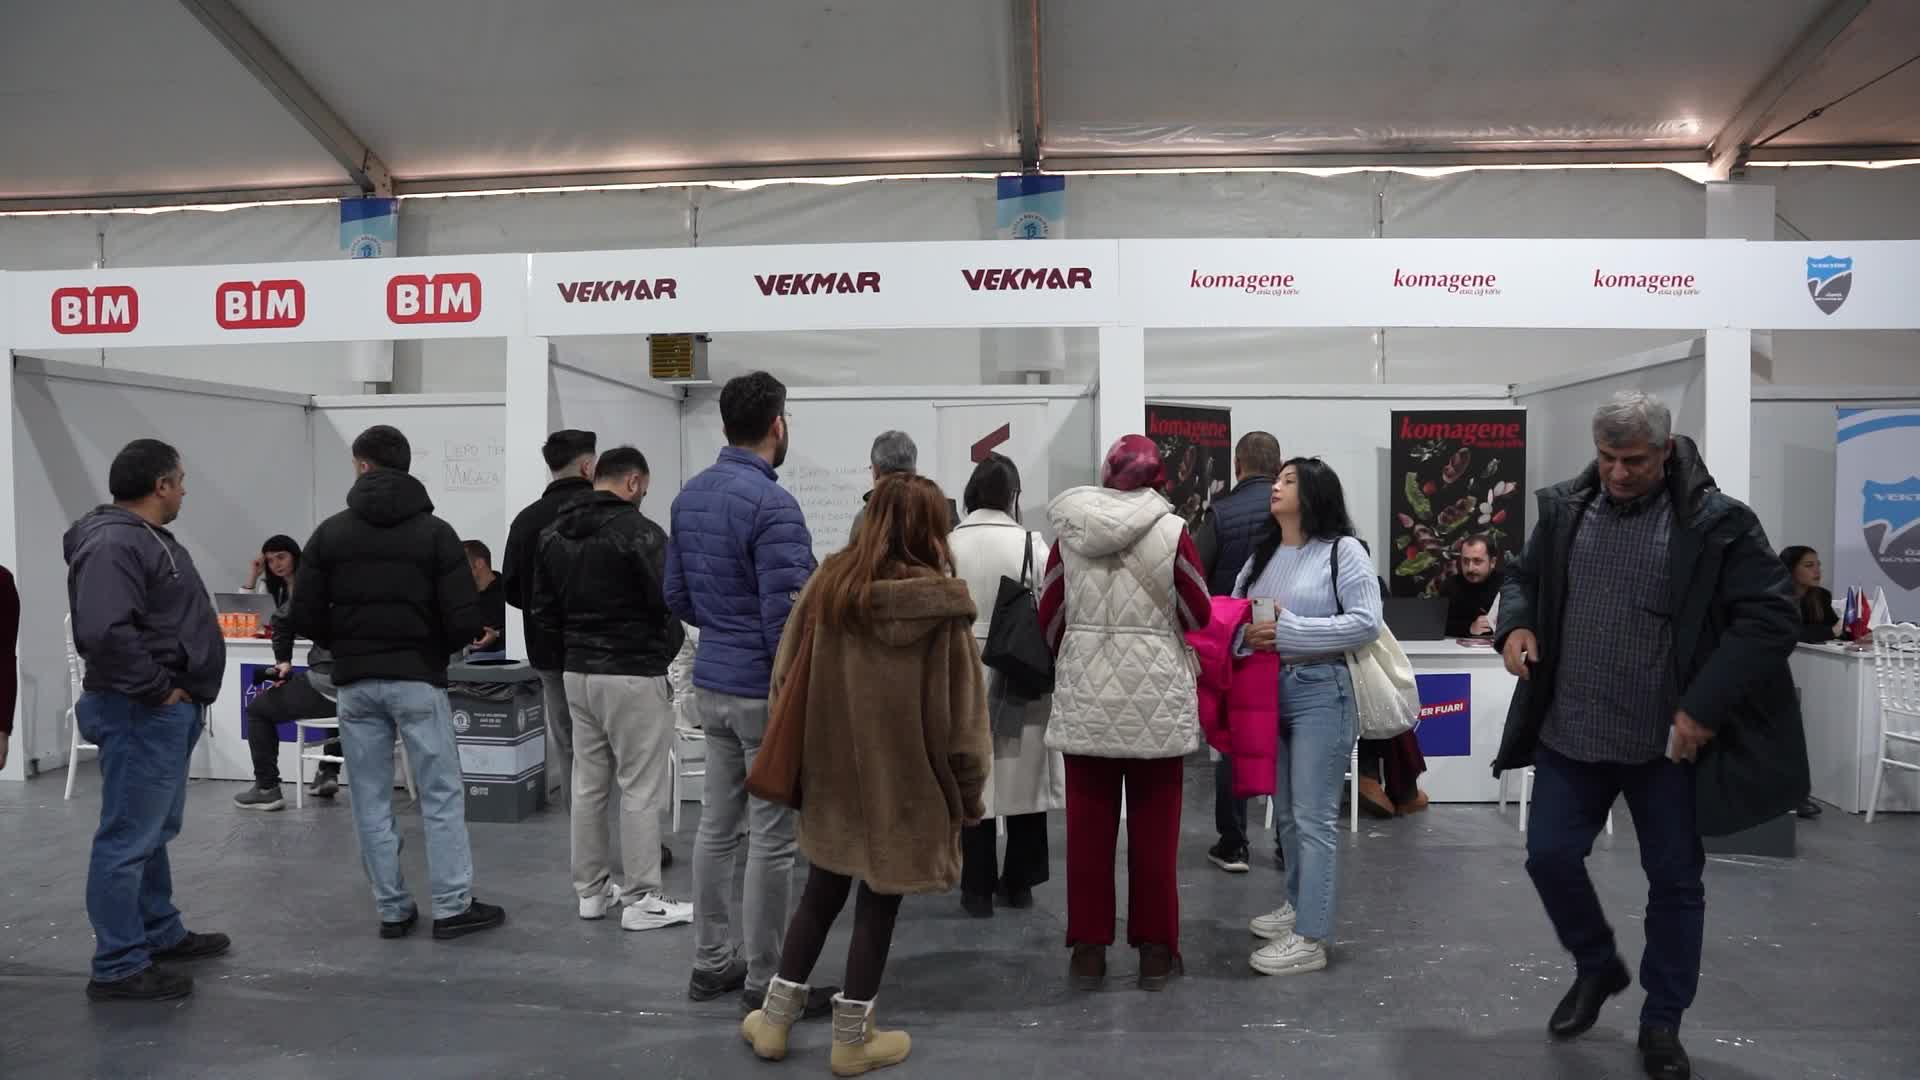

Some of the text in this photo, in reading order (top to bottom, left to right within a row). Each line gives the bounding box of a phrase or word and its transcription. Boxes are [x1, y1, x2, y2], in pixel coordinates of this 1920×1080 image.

[557, 278, 677, 303] VEKMAR
[754, 271, 881, 296] VEKMAR
[961, 267, 1092, 291] VEKMAR
[1190, 269, 1294, 294] komagene
[1394, 268, 1496, 293] komagene
[1594, 269, 1695, 294] komagene
[1150, 411, 1227, 443] komagene
[1400, 416, 1521, 446] komagene
[1434, 703, 1464, 715] FUARI
